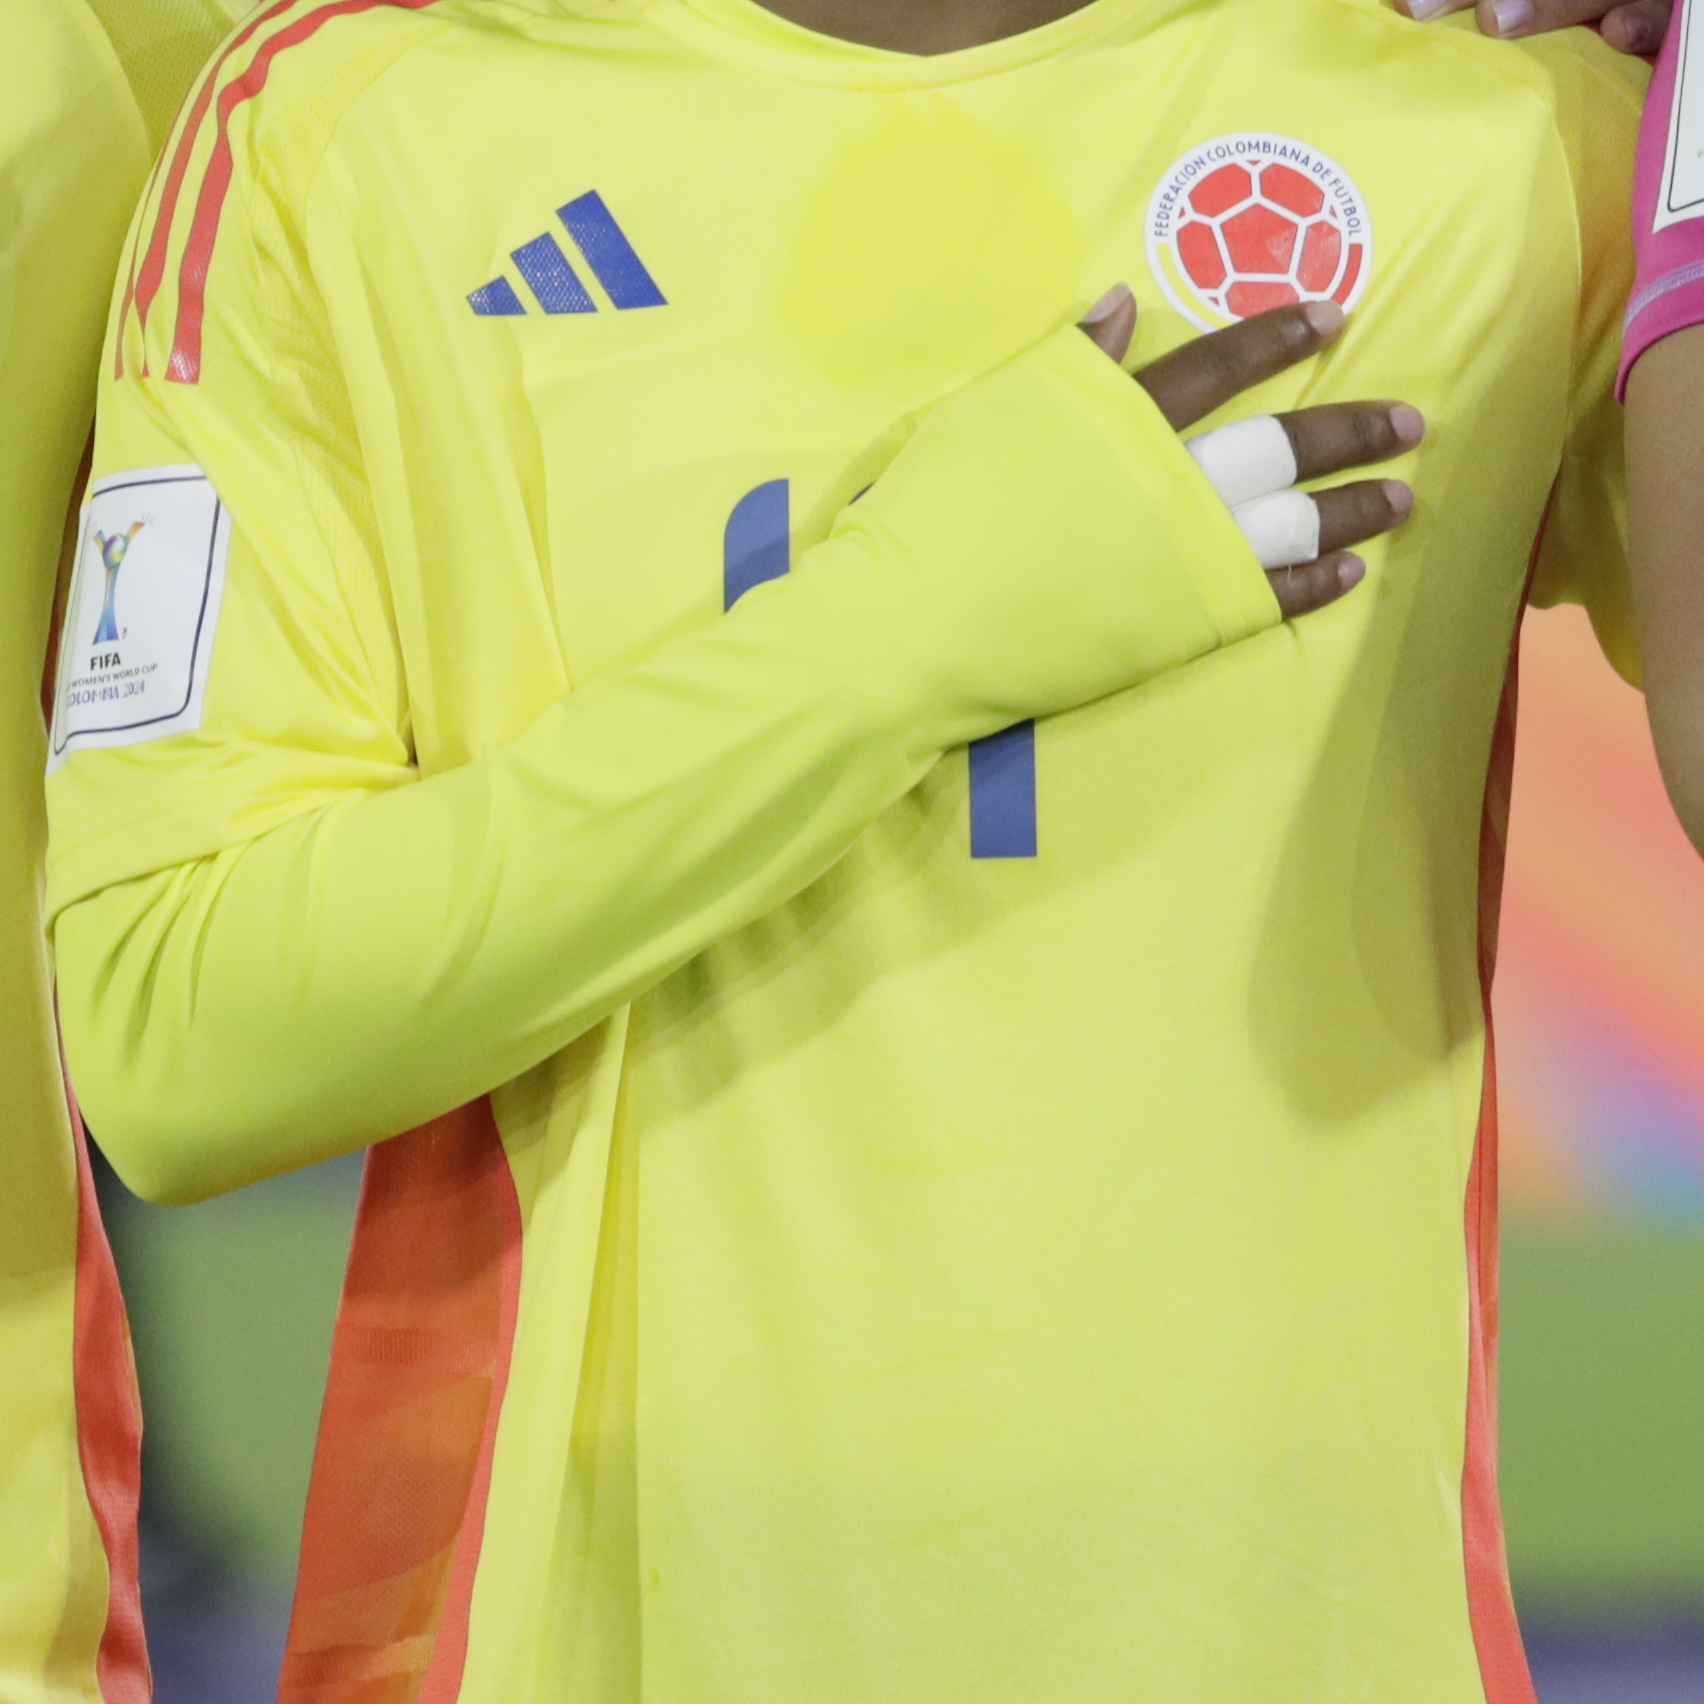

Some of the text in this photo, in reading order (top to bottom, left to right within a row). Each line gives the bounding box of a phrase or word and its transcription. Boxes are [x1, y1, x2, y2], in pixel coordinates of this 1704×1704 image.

[1207, 140, 1310, 167] COLOMBIANA
[1312, 161, 1330, 180] DE
[90, 651, 121, 672] FIFA
[71, 673, 111, 688] WOMEN'S
[112, 667, 139, 681] WORLD
[141, 663, 158, 675] CUP
[123, 679, 145, 698] 2024
